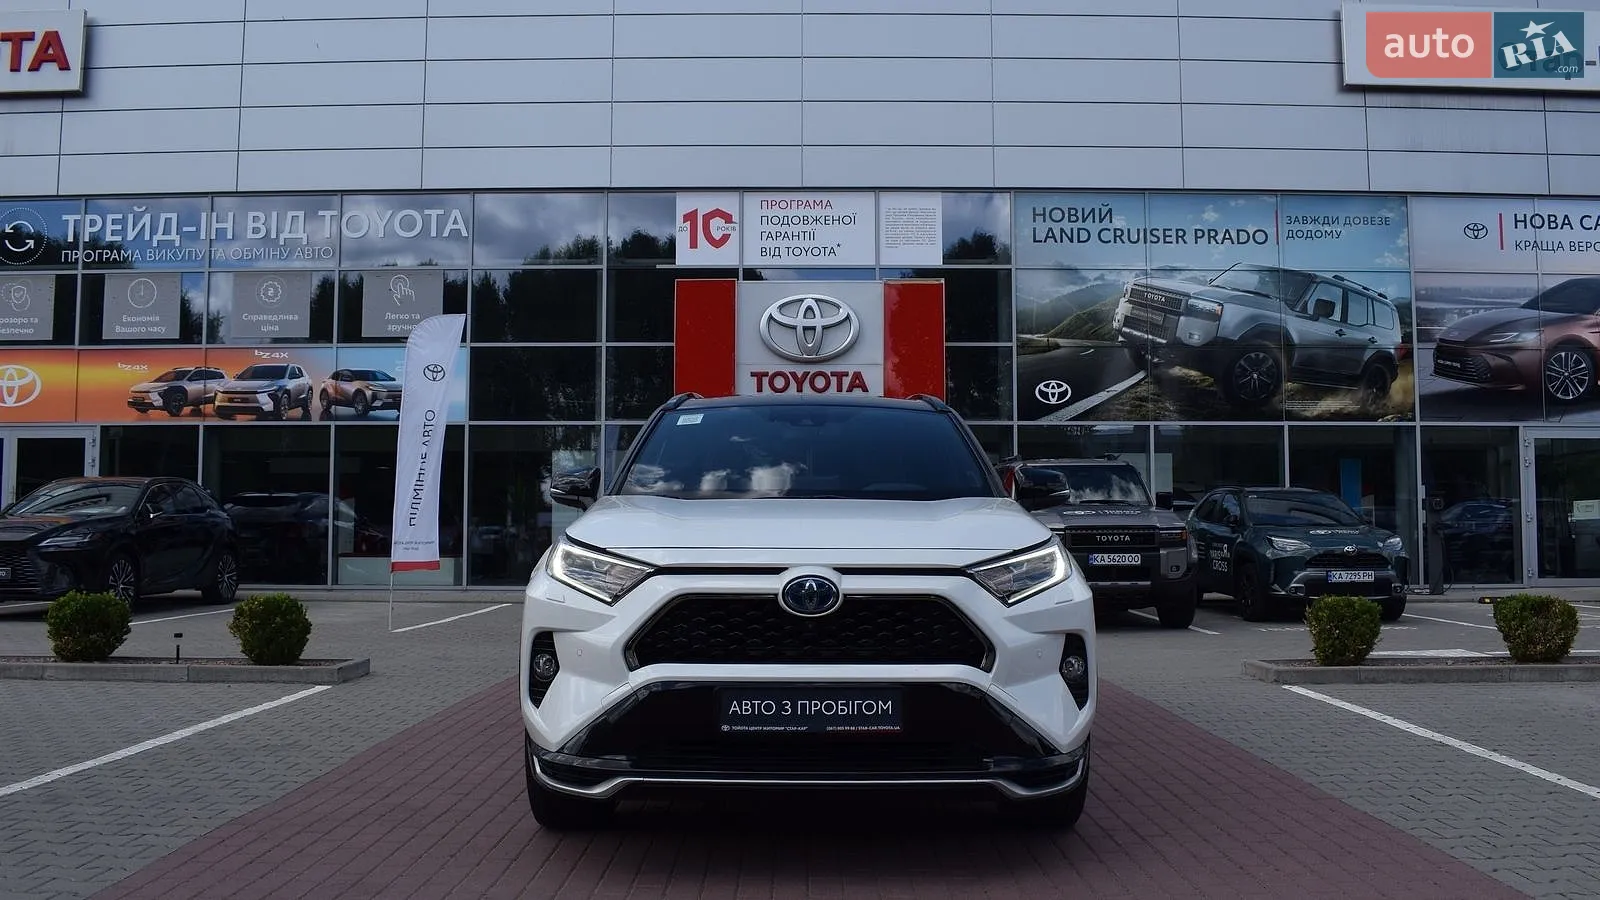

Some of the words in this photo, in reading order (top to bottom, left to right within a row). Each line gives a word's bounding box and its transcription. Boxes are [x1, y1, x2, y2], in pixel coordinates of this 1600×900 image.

[760, 199, 833, 210] ПРОГРАМА
[760, 213, 857, 227] ПОДОВЖЕНОЇ
[1032, 203, 1113, 224] НОВИЙ
[61, 206, 233, 247] ТРЕЙД-ІН
[246, 211, 308, 245] ВІД
[318, 208, 469, 239] TOYOTA
[1285, 215, 1340, 227] ЗАВЖДИ
[1343, 215, 1391, 227] ДОВЕЗЕ
[1514, 213, 1573, 230] НОВА
[760, 228, 816, 241] ГАРАНТІЇ
[1032, 227, 1091, 244] LAND
[1097, 227, 1187, 245] CRUISER
[1194, 229, 1269, 246] PRADO
[1285, 229, 1342, 241] ДОДОМУ
[760, 246, 782, 259] ВІД
[1515, 239, 1565, 254] КРАЩА
[61, 249, 142, 263] ПРОГРАМА
[146, 248, 205, 263] ВИКУПУ
[210, 248, 226, 260] ТА
[230, 247, 290, 261] ОБМІНУ
[294, 246, 333, 260] АВТО
[1144, 292, 1166, 302] TOYOTA
[122, 314, 160, 322] Економія
[242, 312, 299, 323] Справедлива
[384, 312, 410, 320] Легко
[115, 325, 146, 333] Вашого
[147, 326, 166, 335] часу
[260, 324, 280, 333] ціна
[750, 371, 870, 393] TOYOTA
[1107, 554, 1127, 564] 5620
[729, 700, 776, 715] АВТО
[797, 700, 892, 715] ПРОБІГОМ
